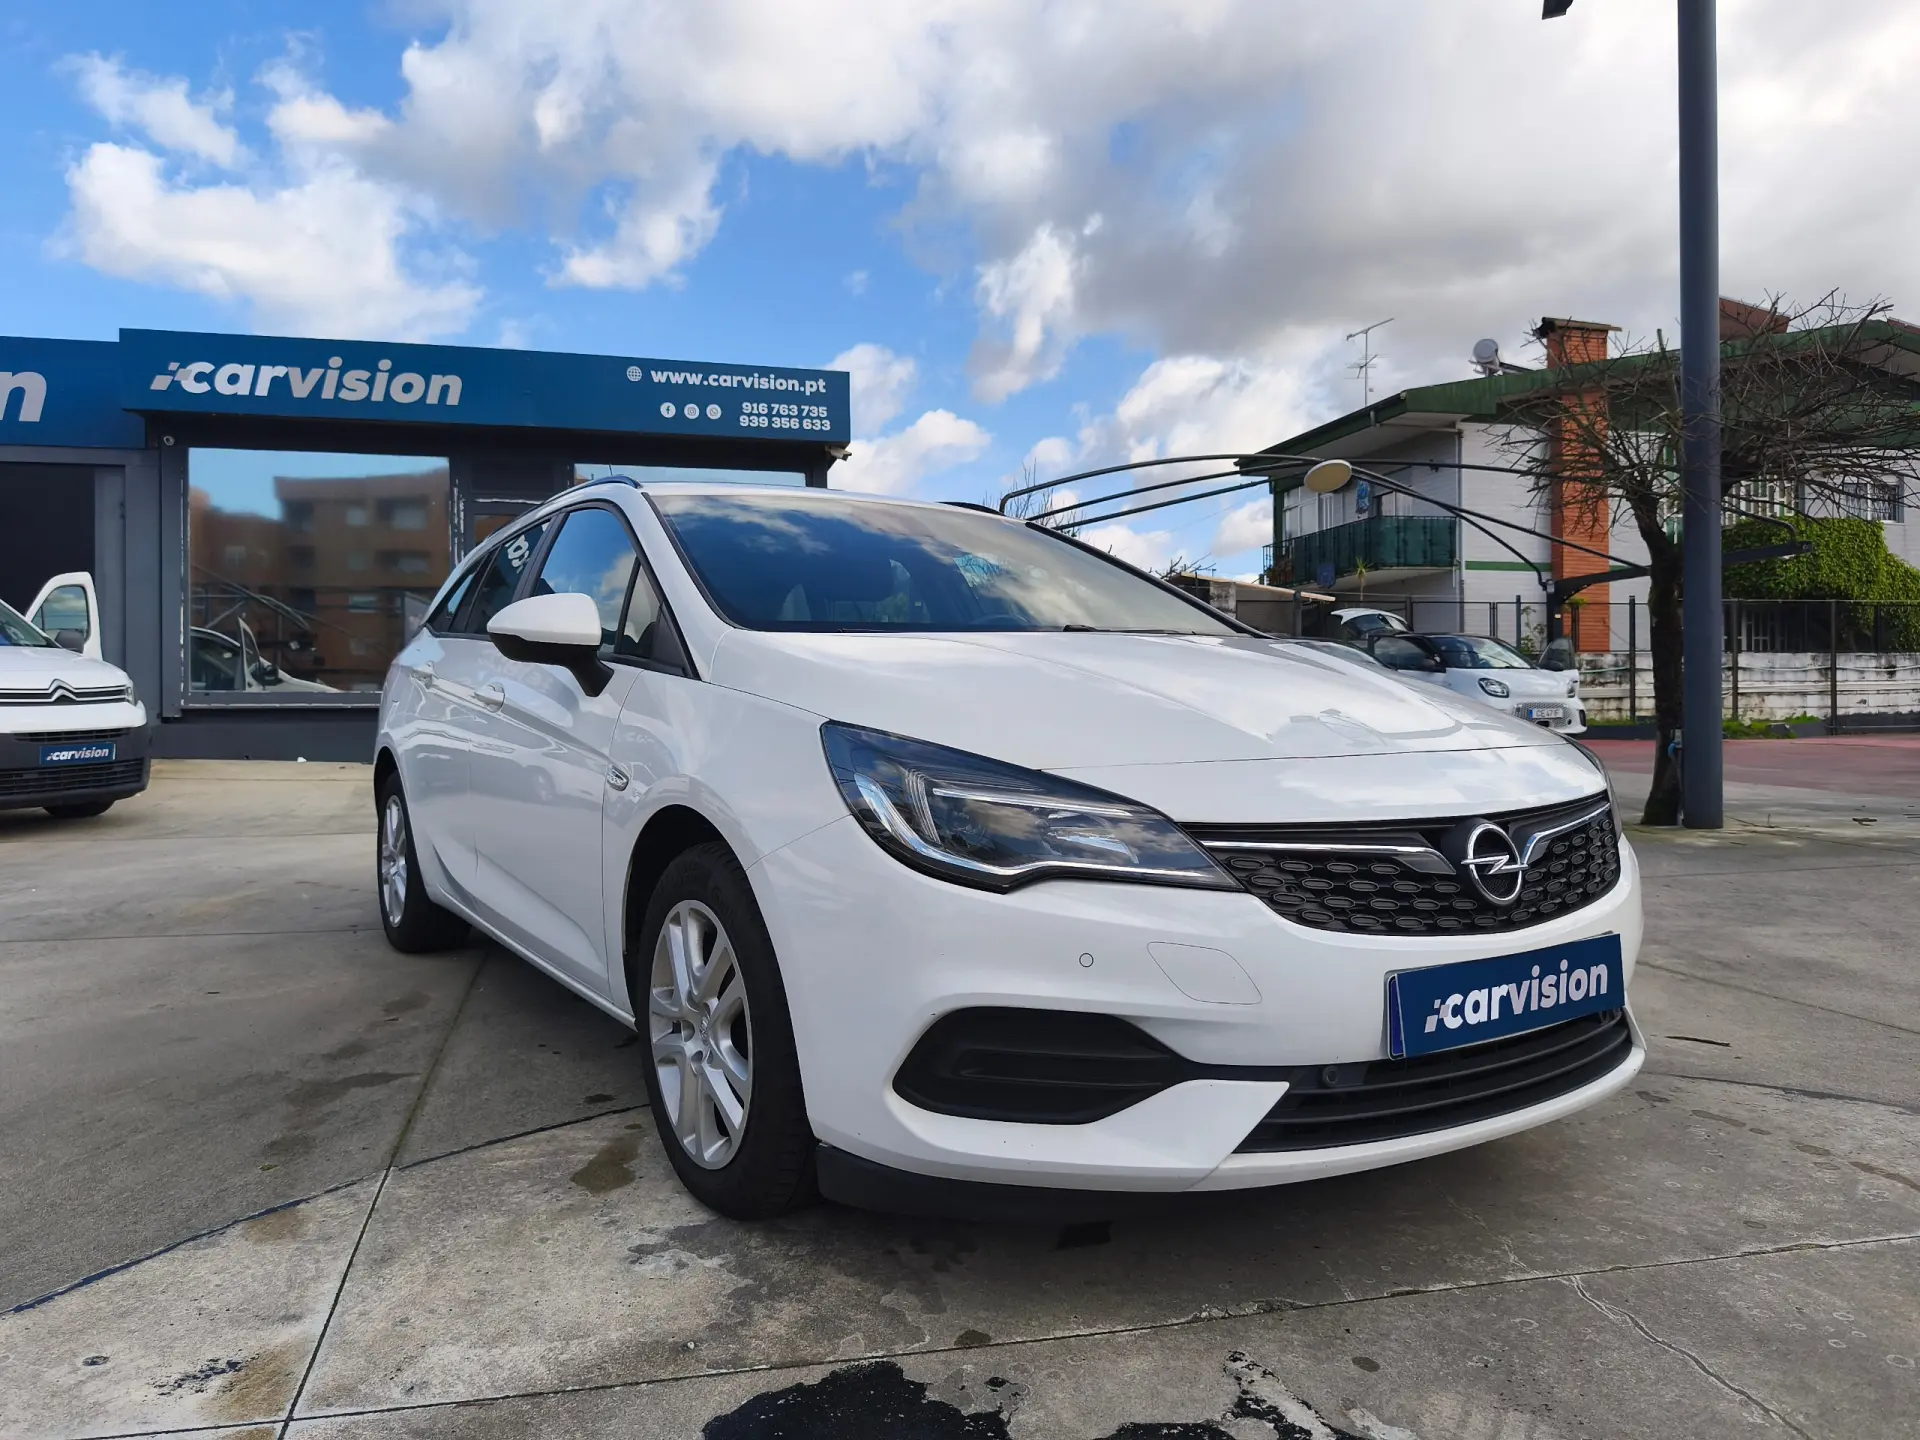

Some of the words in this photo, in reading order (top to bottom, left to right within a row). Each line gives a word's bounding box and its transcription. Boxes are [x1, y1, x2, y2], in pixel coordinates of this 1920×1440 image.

[178, 356, 463, 406] carvision
[650, 369, 827, 395] www.carvision.pt
[742, 402, 768, 414] 916
[771, 403, 798, 416] 763
[801, 405, 828, 418] 735
[740, 415, 769, 427] 939
[772, 417, 800, 429] 356
[802, 418, 831, 430] 633
[51, 747, 109, 761] carvision
[1436, 959, 1608, 1030] carvision
